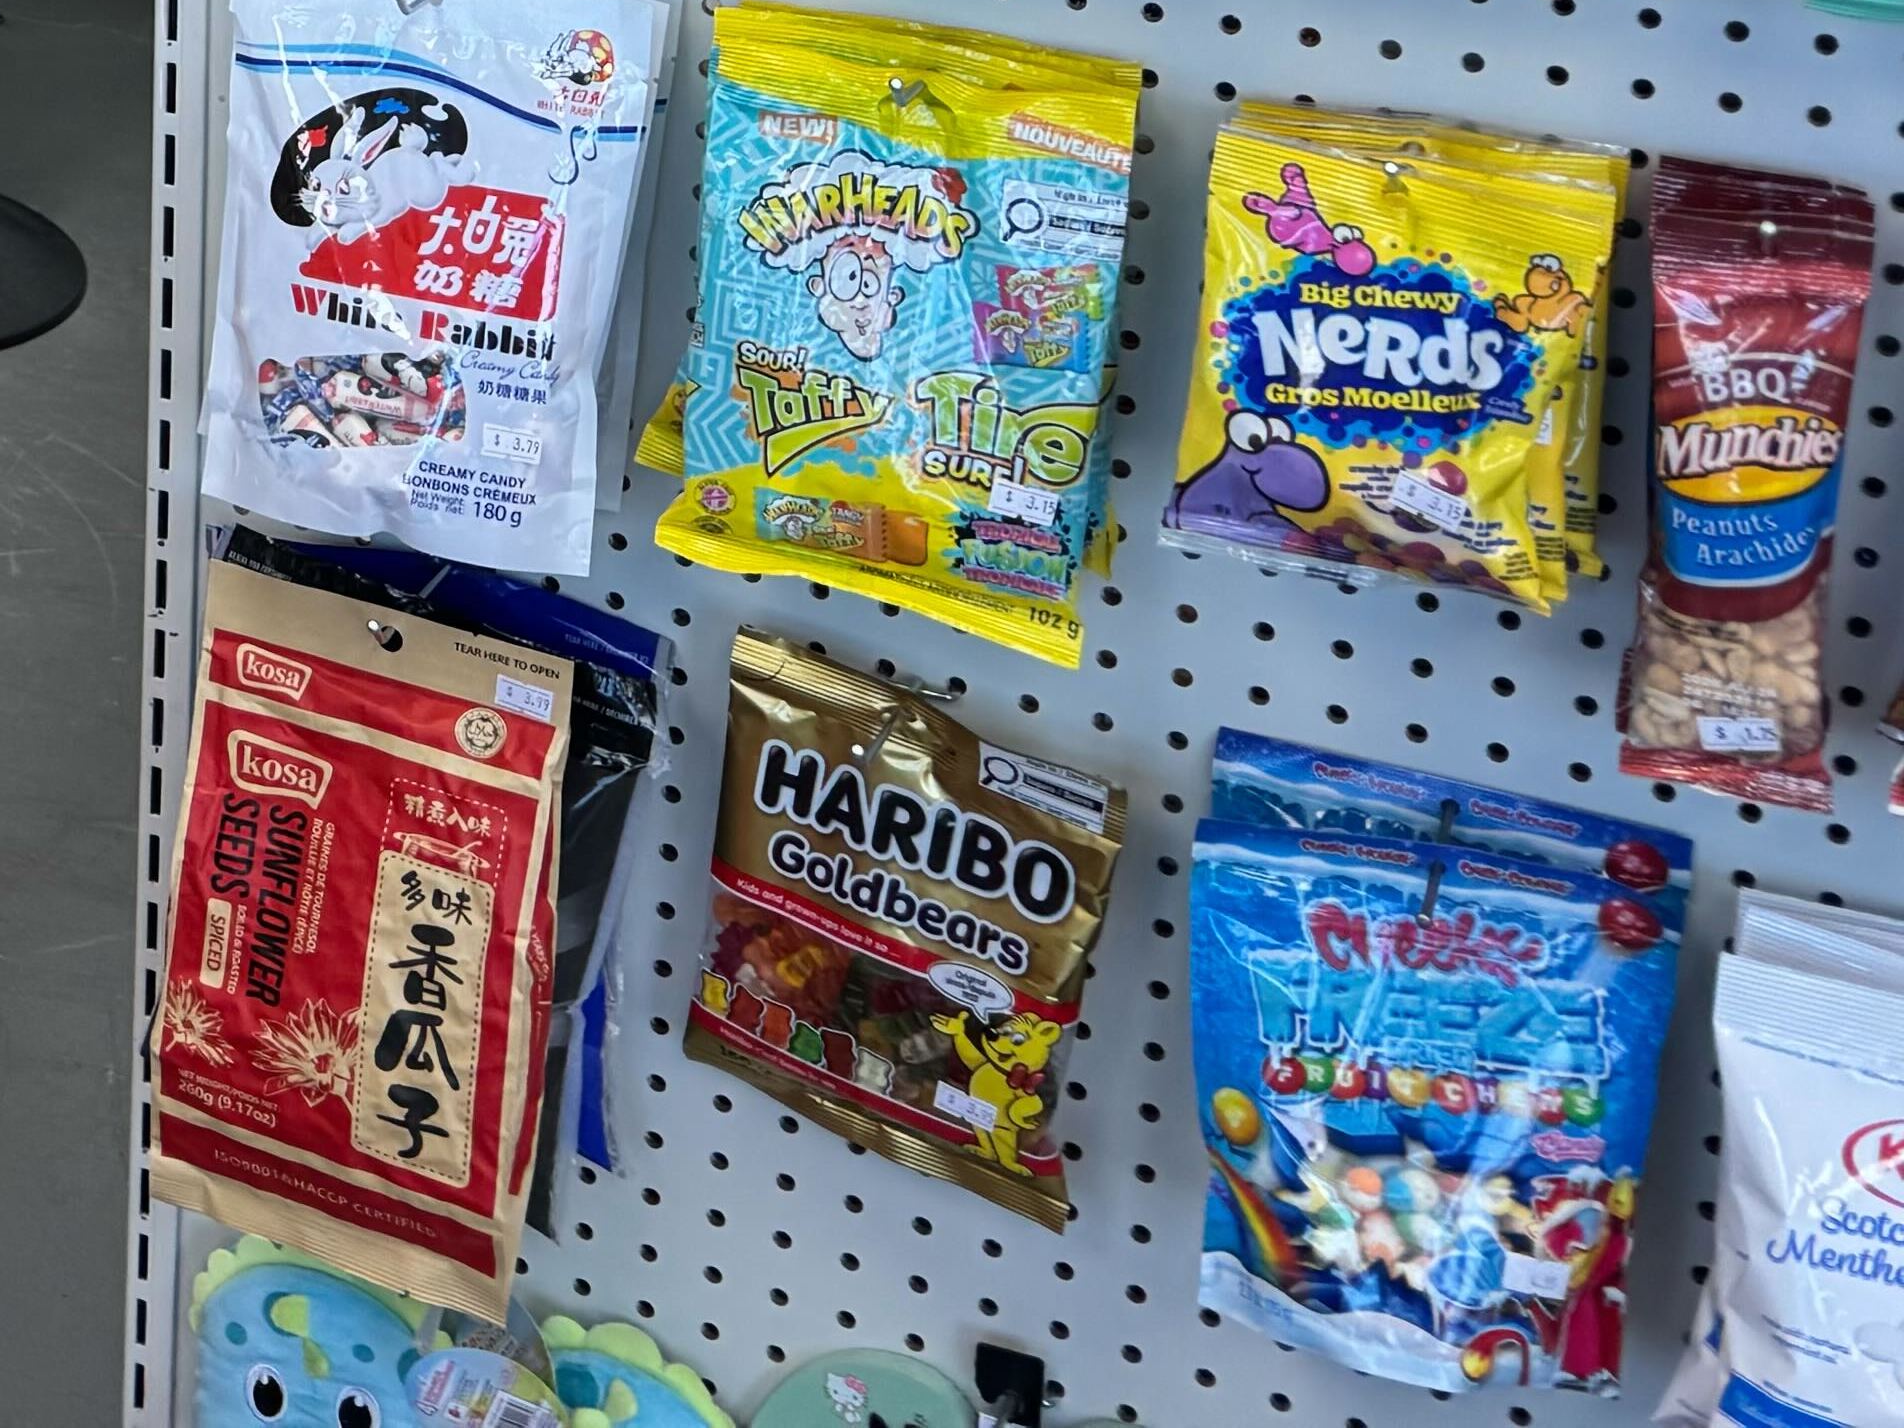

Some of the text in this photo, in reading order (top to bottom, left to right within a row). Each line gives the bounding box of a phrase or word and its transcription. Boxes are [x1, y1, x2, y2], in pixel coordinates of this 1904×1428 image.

[761, 114, 837, 139] NEW!
[417, 195, 542, 266] 大白兔
[737, 175, 968, 257] WARHEADS
[413, 262, 525, 312] 奶糖
[1299, 282, 1462, 315] Big Chewy
[419, 308, 557, 362] Rabbit
[460, 349, 561, 389] Creamy Candy
[737, 342, 807, 374] SOUR!
[478, 379, 547, 404] 奶糖糖果
[1265, 383, 1339, 406] Gros
[1342, 389, 1482, 414] Moelleux
[1703, 367, 1790, 404] BBQ
[736, 363, 890, 477] Taffy
[915, 369, 1110, 486] Tire
[513, 437, 540, 455] 3.79
[1657, 416, 1843, 479] Munchies
[419, 460, 526, 489] CREAMY CANDY
[473, 485, 537, 505] CRÉMEUX
[474, 501, 522, 528] 180 g
[1025, 496, 1056, 515] 3.15
[1672, 506, 1779, 536] Peanuts
[960, 538, 1071, 583] FUSION
[1029, 605, 1080, 641] 102 g
[246, 654, 301, 689] kosa
[454, 642, 560, 680] TEAR HERE TO OPEN
[242, 746, 318, 792] kosa
[211, 792, 261, 899] SEEDS
[756, 741, 1075, 924] HARIBO
[246, 805, 308, 1008] SUNFLOWER
[400, 869, 473, 927] 多味
[736, 877, 863, 942] Kids and grown-ups love
[769, 830, 1031, 975] Goldbears
[205, 914, 222, 972] SPICED
[373, 922, 463, 1160] 香瓜子
[178, 1079, 277, 1129] 260g (9.17oz)
[352, 1202, 437, 1239] CERTIFIED
[1821, 1197, 1904, 1243] Scotc
